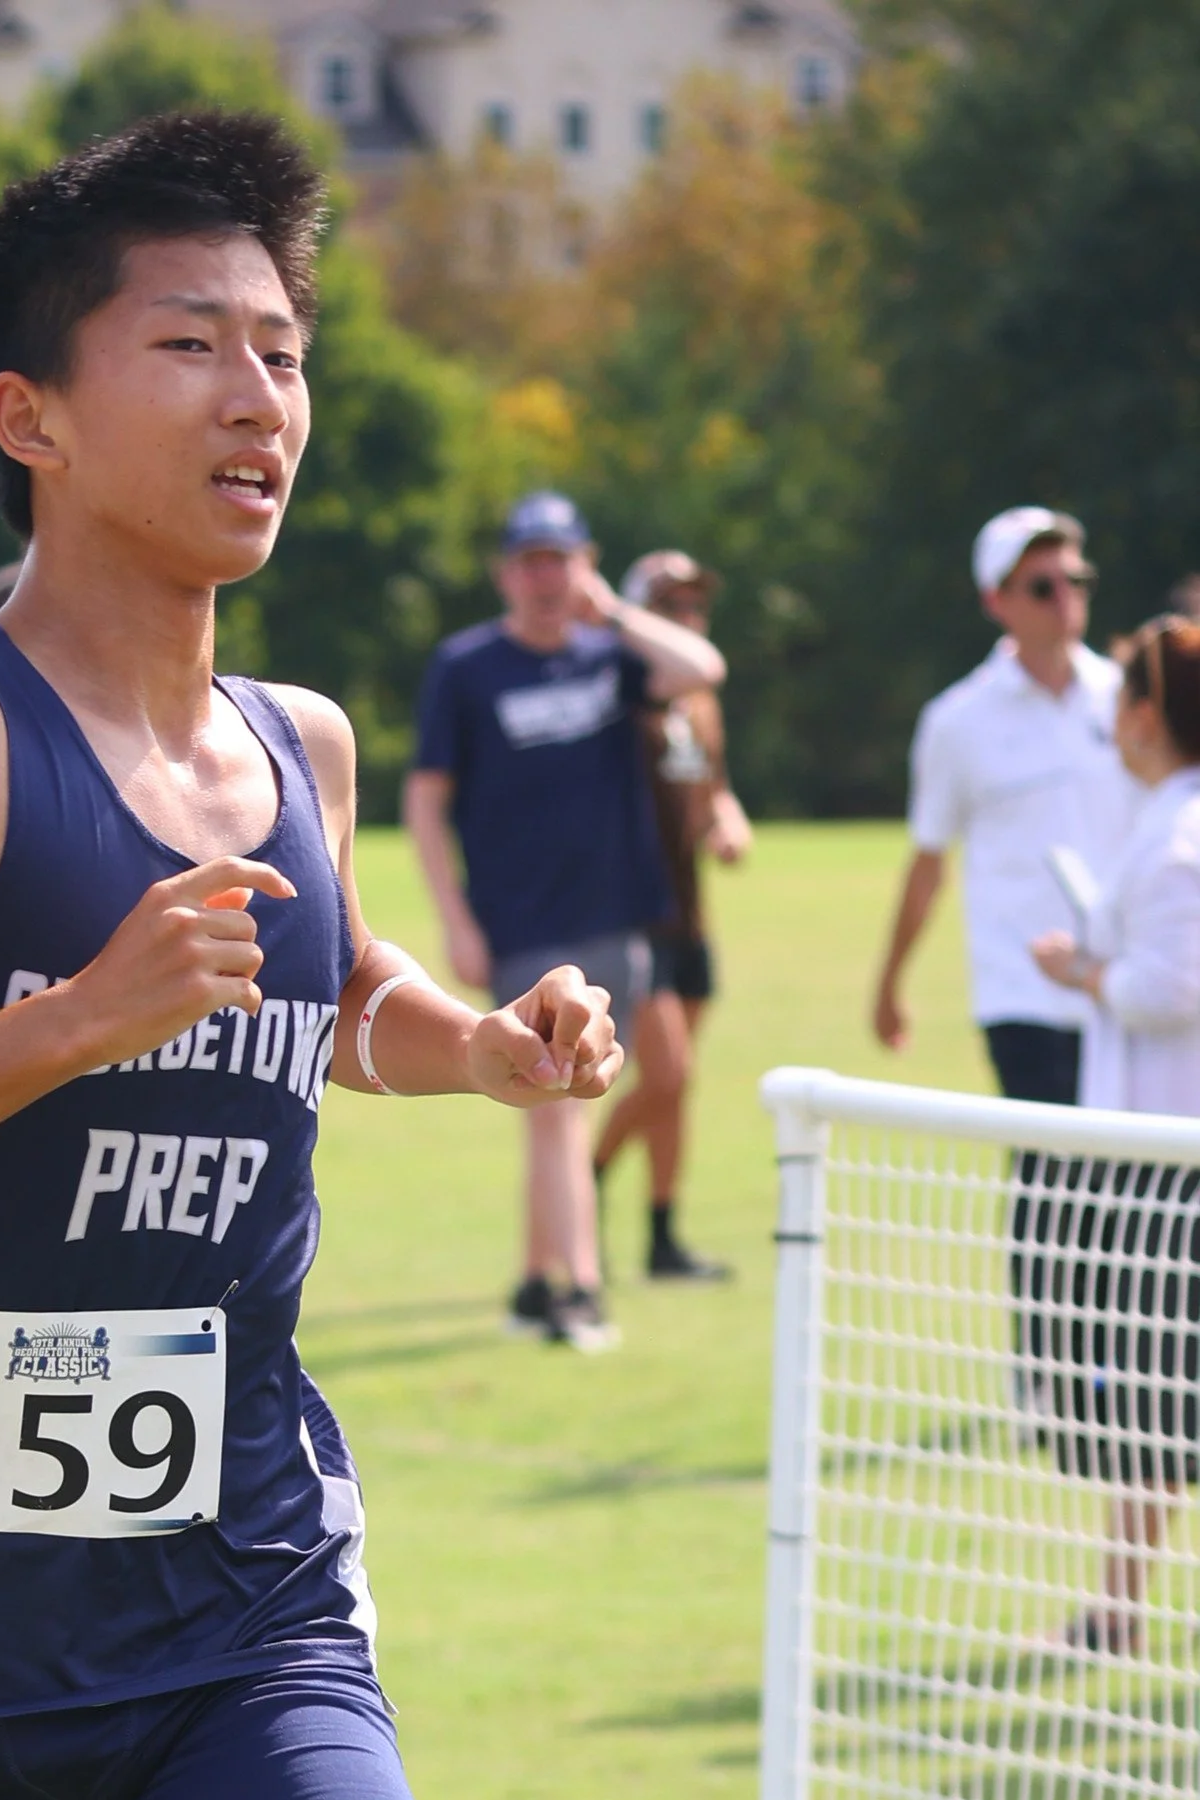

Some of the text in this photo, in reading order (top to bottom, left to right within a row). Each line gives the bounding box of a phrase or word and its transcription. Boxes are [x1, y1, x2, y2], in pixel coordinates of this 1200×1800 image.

[64, 1128, 269, 1244] PREP
[31, 1338, 92, 1347] 49TH ANNUAL
[14, 1347, 104, 1357] GEORGETOWN PREP
[18, 1357, 101, 1377] CLASSIC
